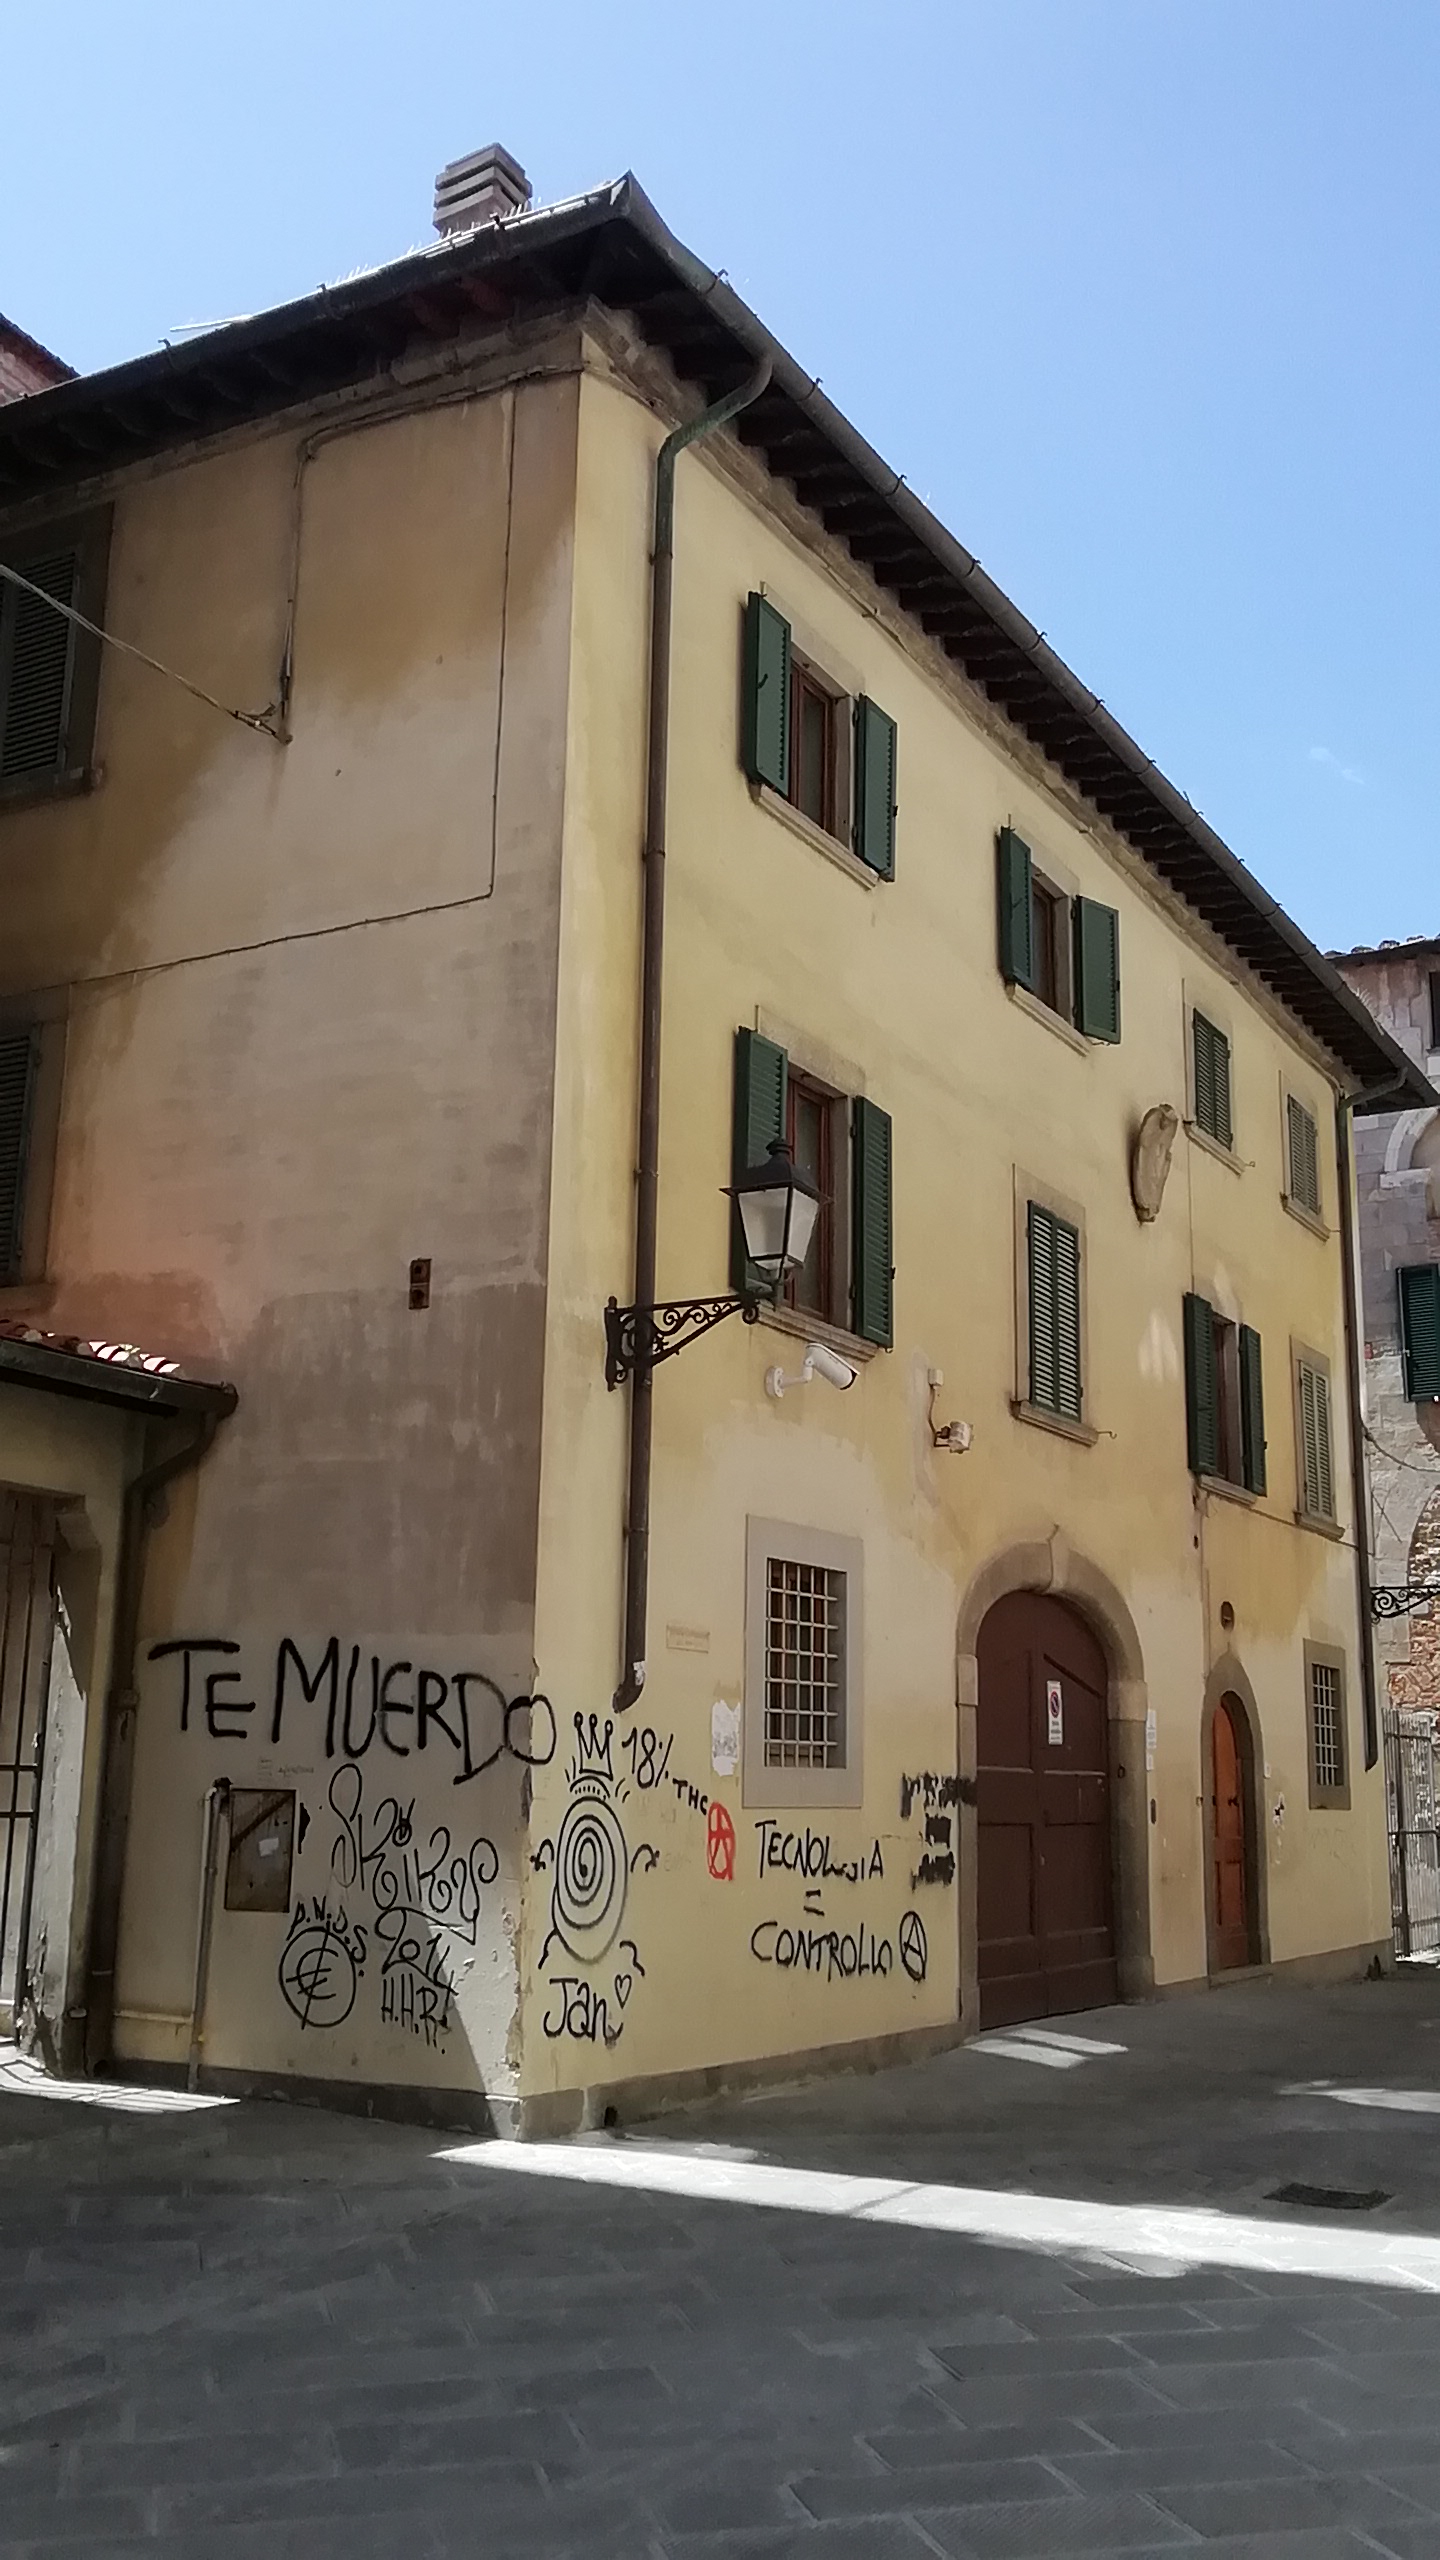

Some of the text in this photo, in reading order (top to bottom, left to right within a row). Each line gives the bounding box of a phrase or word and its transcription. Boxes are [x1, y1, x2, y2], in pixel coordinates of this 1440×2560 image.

[148, 1636, 557, 1785] TE MUERDO
[672, 1777, 709, 1816] THC
[751, 1921, 893, 1982] CONTROLLO
